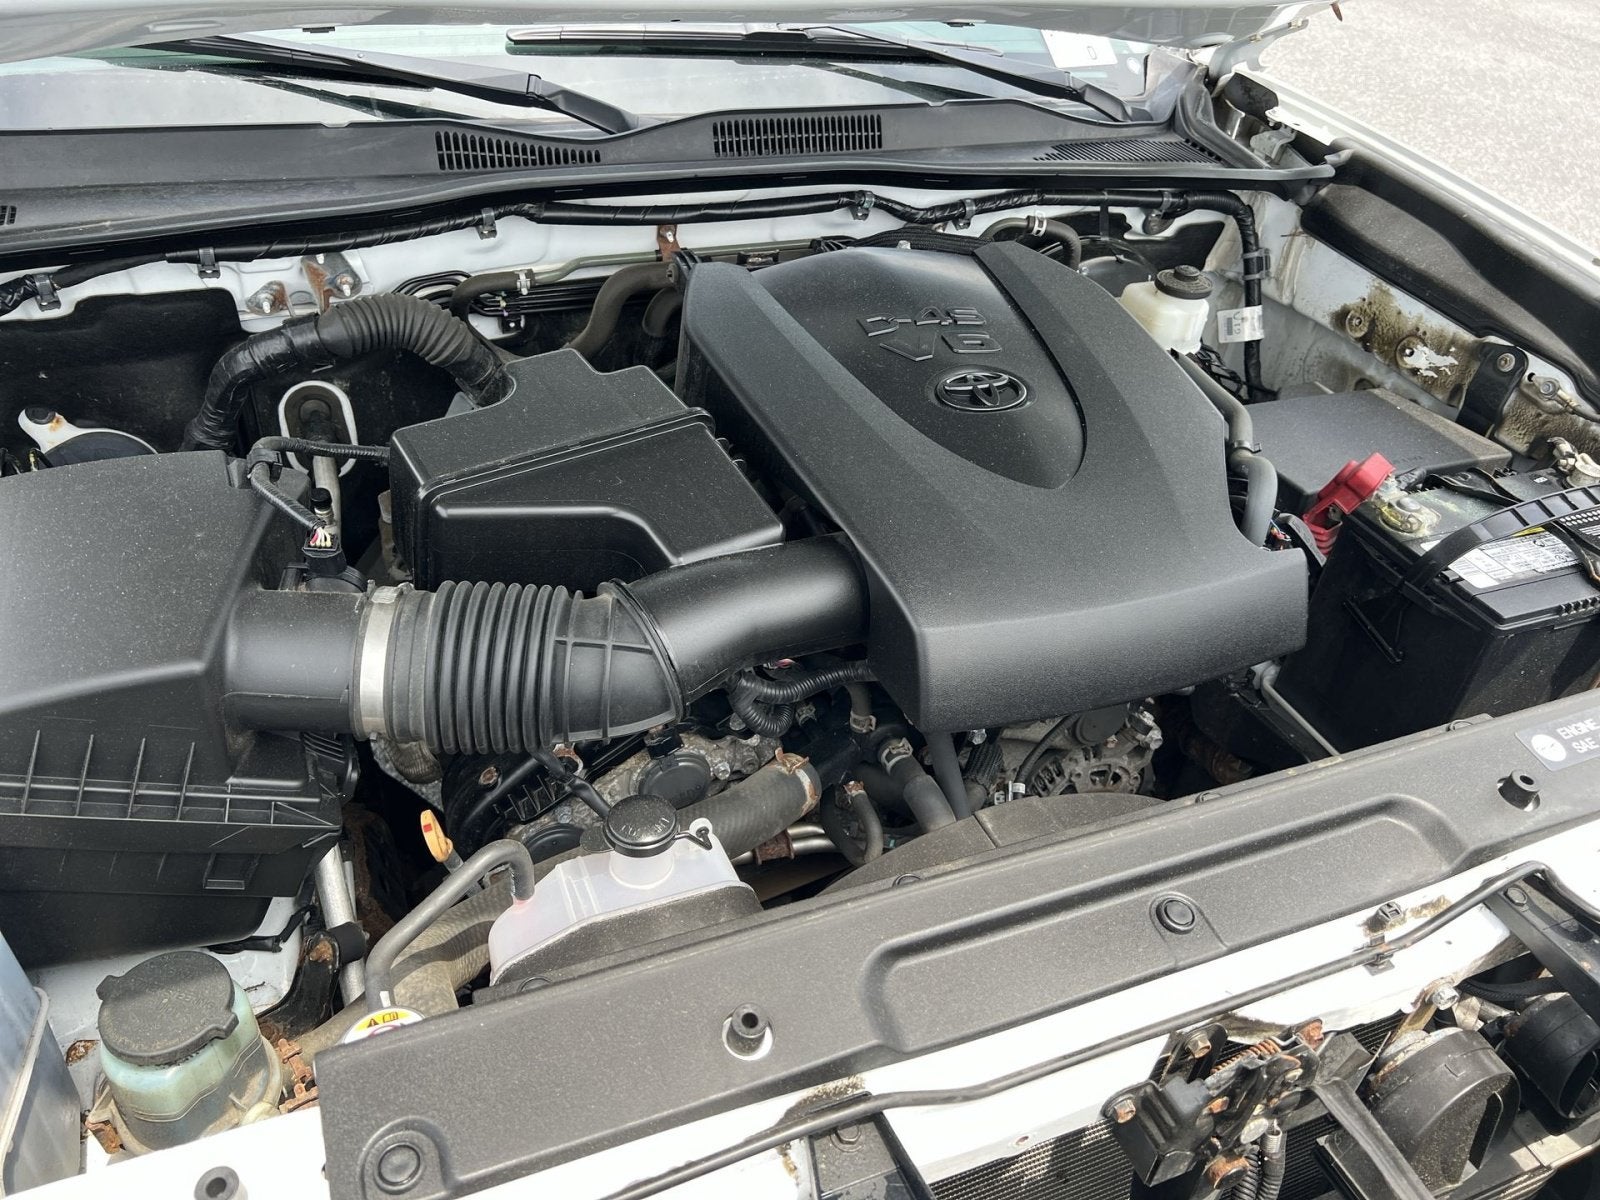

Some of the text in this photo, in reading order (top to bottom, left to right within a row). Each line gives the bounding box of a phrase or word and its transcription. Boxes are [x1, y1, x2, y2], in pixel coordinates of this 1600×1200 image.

[857, 306, 986, 336] D-4S
[878, 331, 1002, 361] V6
[1557, 719, 1600, 740] ENGINE
[1572, 738, 1600, 753] SAE
